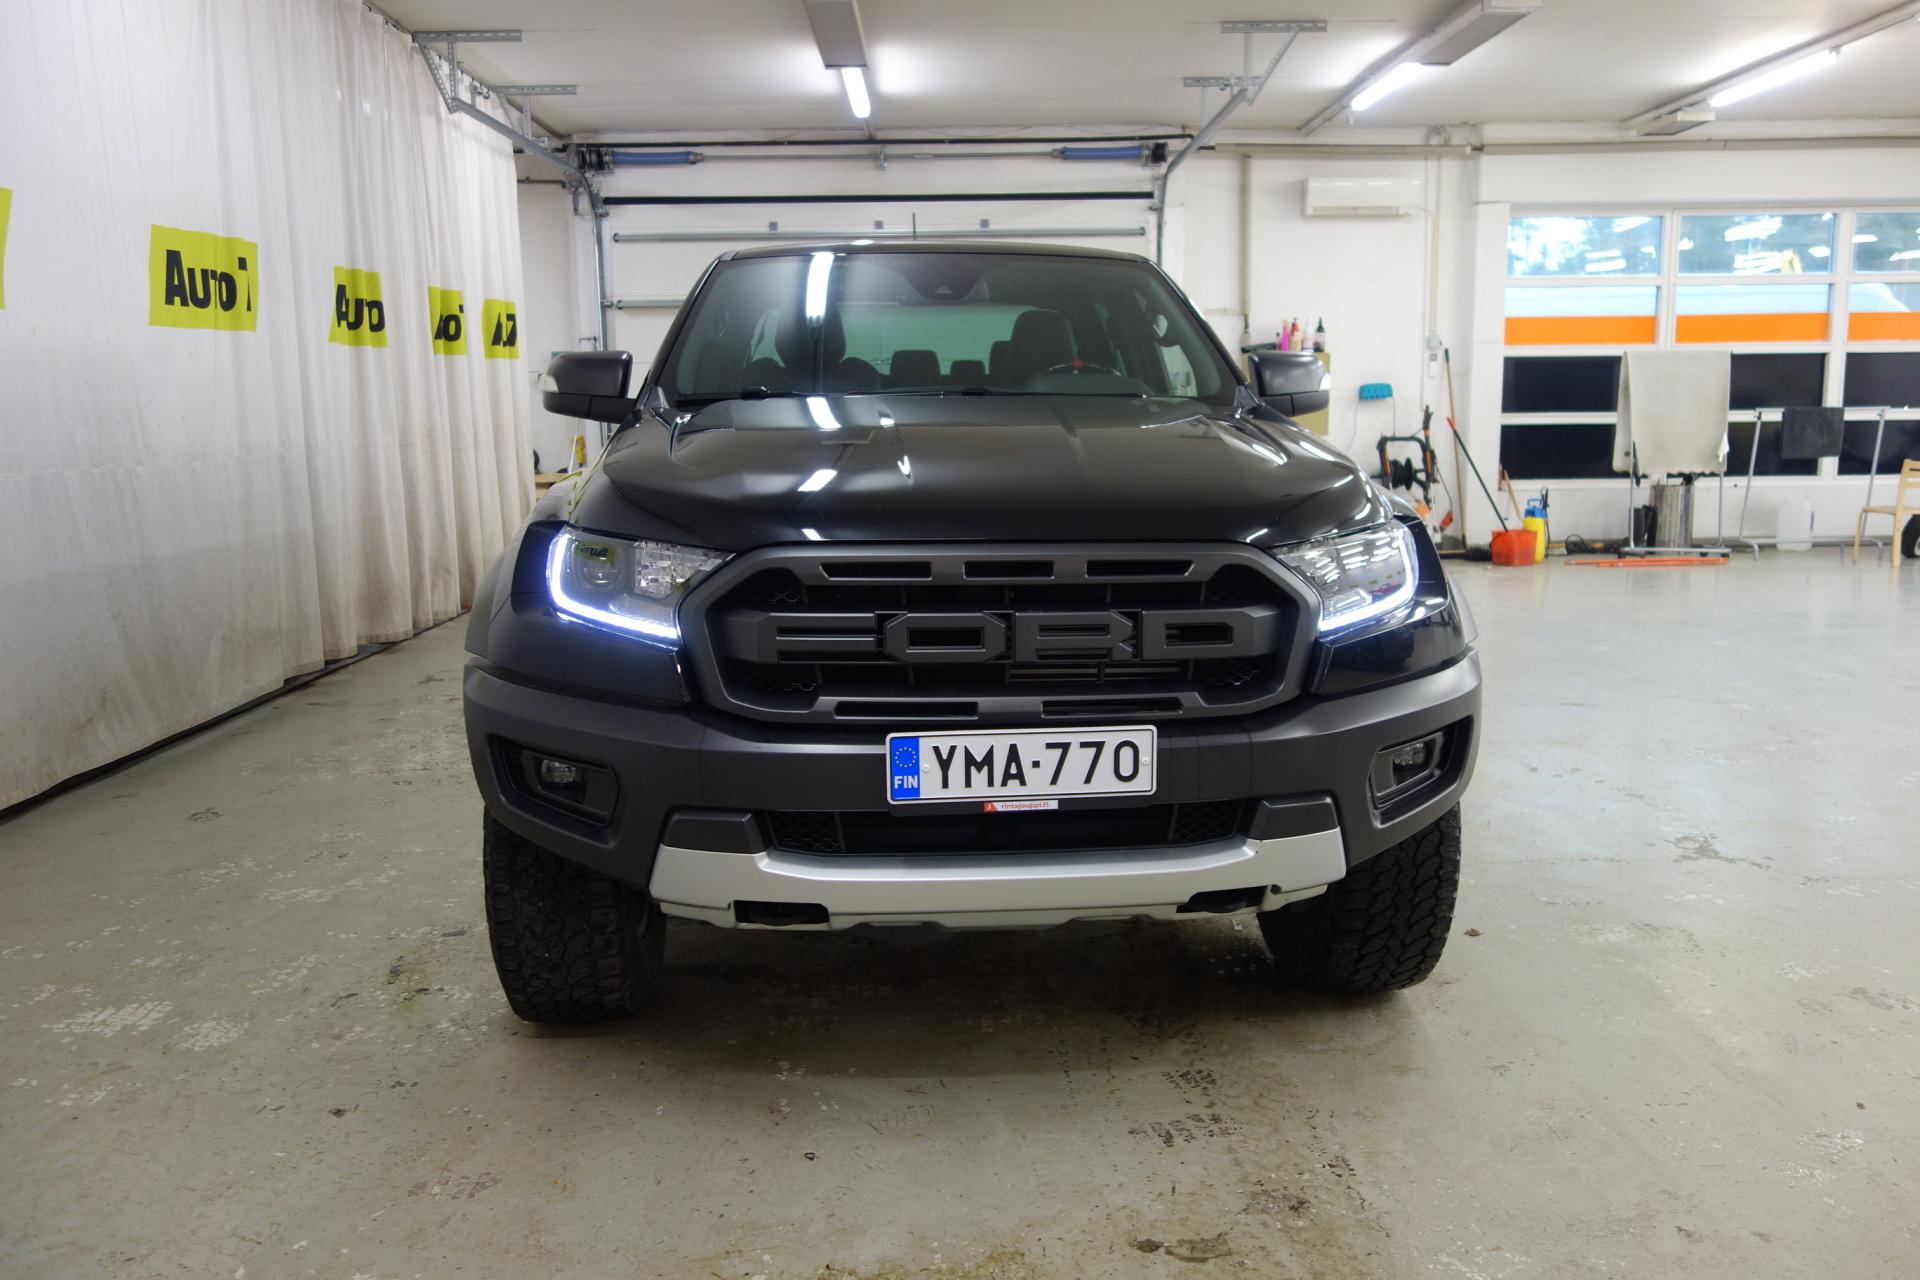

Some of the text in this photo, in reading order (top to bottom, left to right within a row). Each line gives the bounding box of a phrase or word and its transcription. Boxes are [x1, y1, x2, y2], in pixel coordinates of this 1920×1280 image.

[728, 609, 1276, 664] FORD
[894, 740, 1140, 789] FIN YMA-770
